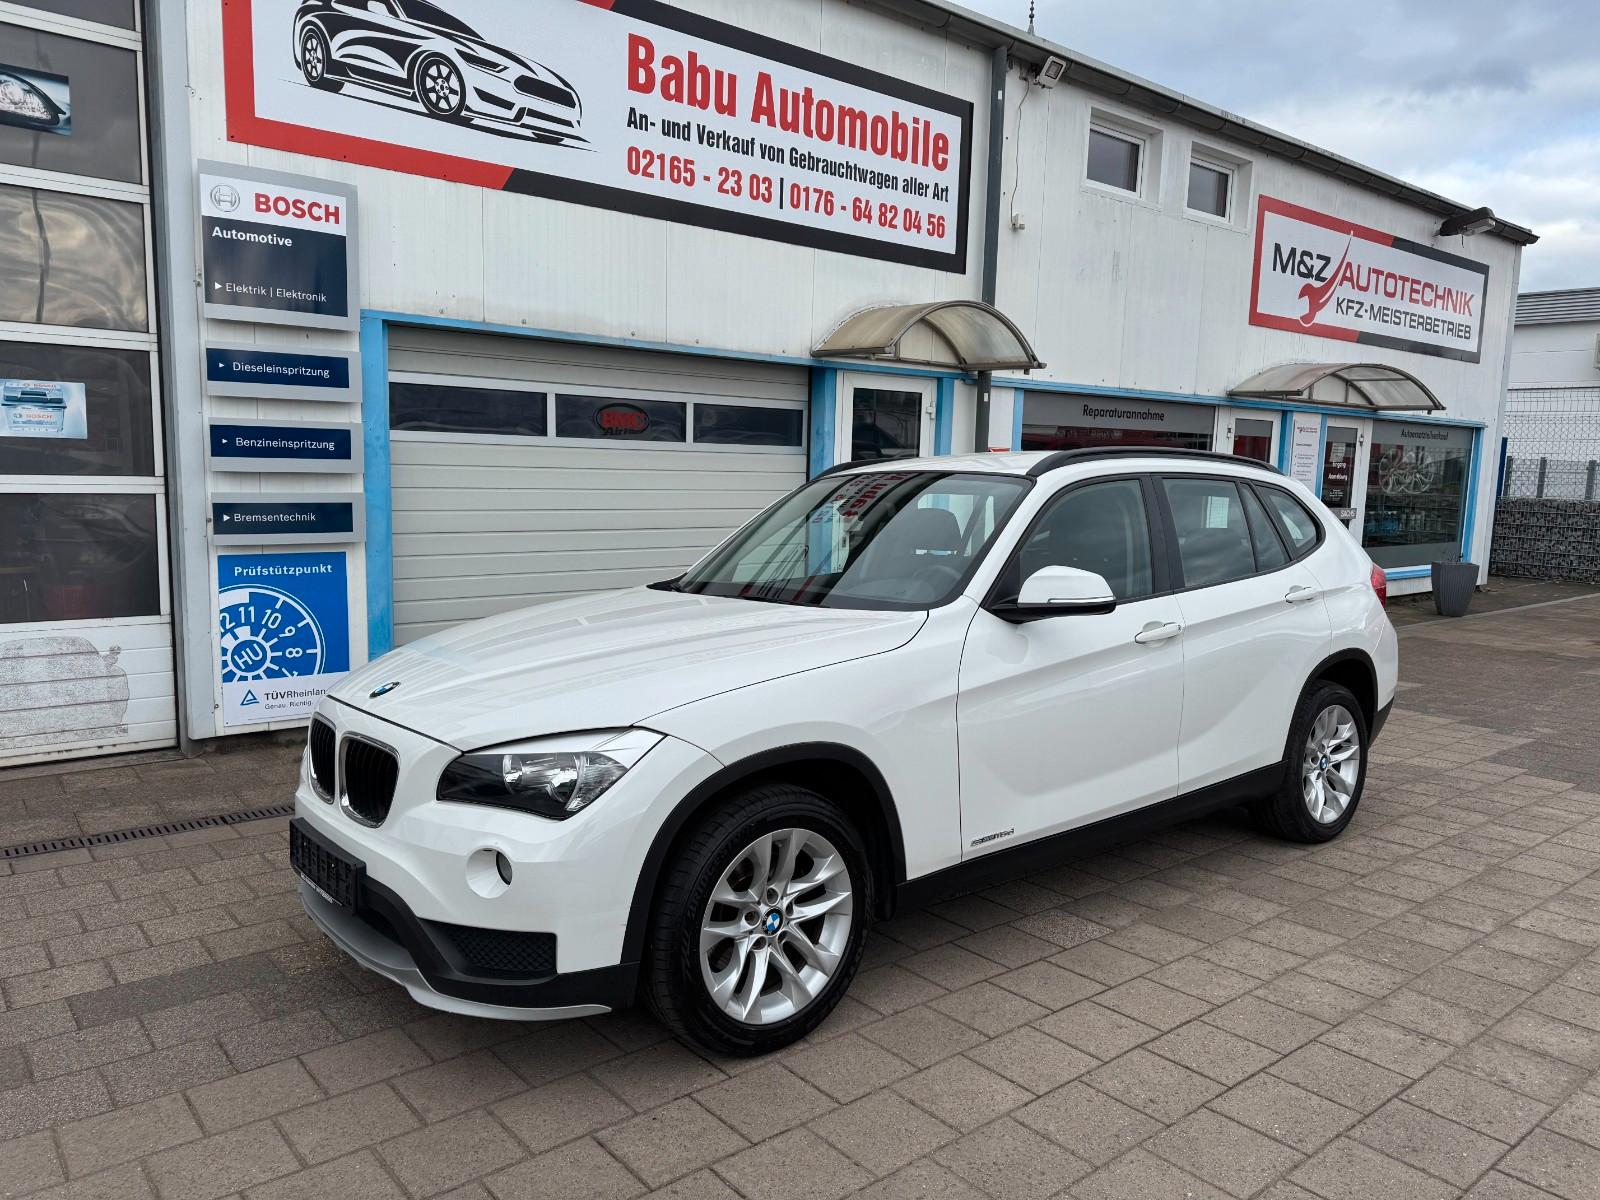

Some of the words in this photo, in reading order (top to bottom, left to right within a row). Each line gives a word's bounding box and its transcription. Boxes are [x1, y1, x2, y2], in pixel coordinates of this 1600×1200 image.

[627, 32, 737, 118] Babu
[750, 71, 949, 172] Automobile
[627, 107, 656, 132] An-
[661, 119, 691, 142] und
[696, 124, 756, 157] Verkauf
[759, 144, 785, 165] von
[789, 147, 898, 193] Gebrauchtwagen
[902, 177, 930, 199] aller
[932, 182, 949, 203] Art
[627, 145, 696, 187] 02165
[717, 166, 742, 197] 23
[748, 173, 773, 204] 03
[789, 182, 834, 217] 0176
[852, 197, 873, 225] 64
[878, 202, 898, 230] 82
[902, 208, 922, 235] 04
[926, 212, 946, 240] 56
[255, 192, 340, 225] BOSCH
[212, 226, 293, 246] Automotive
[1272, 242, 1332, 283] M&Z
[1338, 260, 1475, 317] AUTOTECHNIK
[225, 282, 267, 296] Elektrik
[276, 288, 327, 302] Elektronik
[232, 360, 330, 379] Dieseleinspritzung
[1083, 404, 1165, 421] Reparaturannahme
[235, 436, 336, 452] Benzineinspritzung
[234, 510, 317, 524] Bremsentechnik
[234, 563, 333, 577] Prüfstützpunkt
[238, 606, 255, 623] 11
[262, 609, 282, 629] 10
[279, 626, 296, 637] 9
[233, 643, 263, 669] HU
[285, 648, 303, 658] 8
[264, 688, 326, 701] TÜVRheinlan
